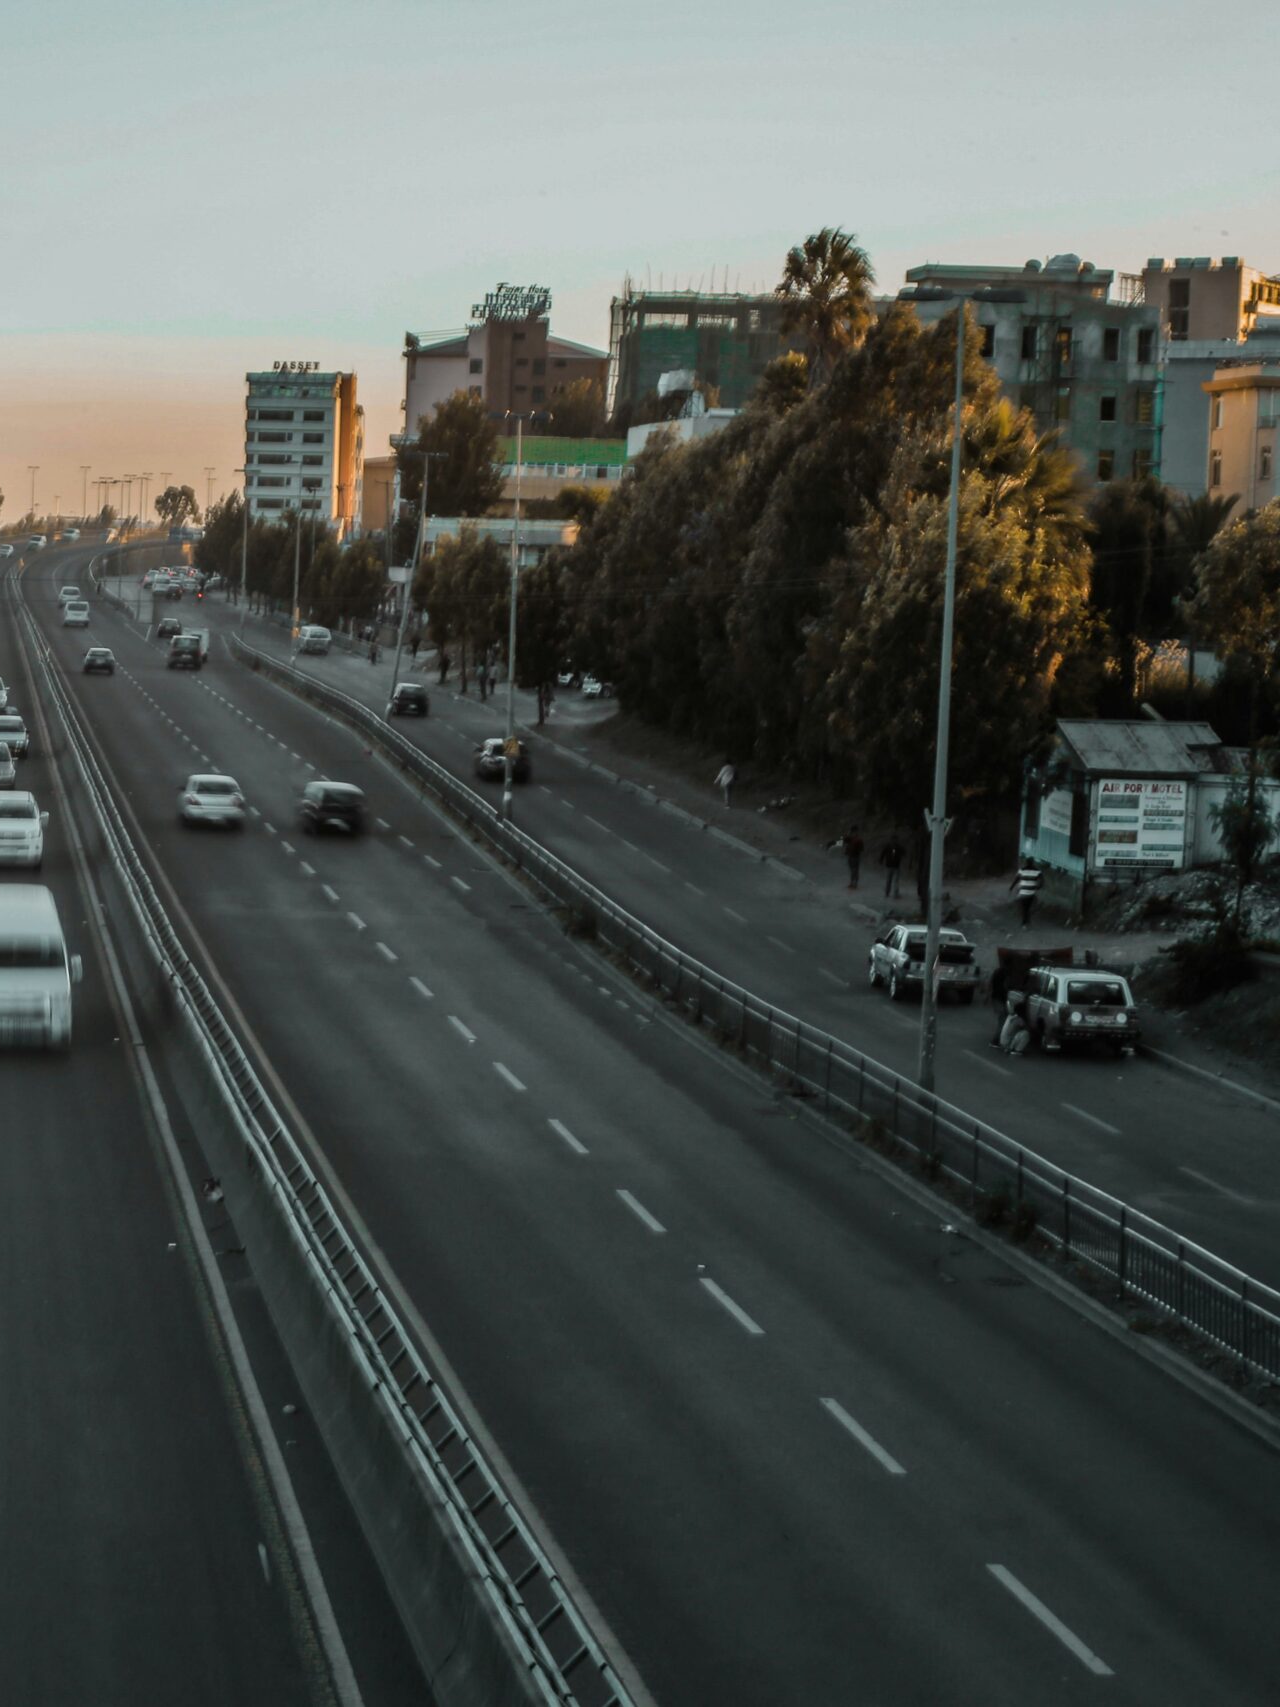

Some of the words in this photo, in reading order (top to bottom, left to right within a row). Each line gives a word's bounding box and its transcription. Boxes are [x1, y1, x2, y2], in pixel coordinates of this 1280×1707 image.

[1102, 783, 1121, 793] AIR
[1124, 783, 1148, 793] PORT
[1151, 783, 1183, 794] MOTEL
